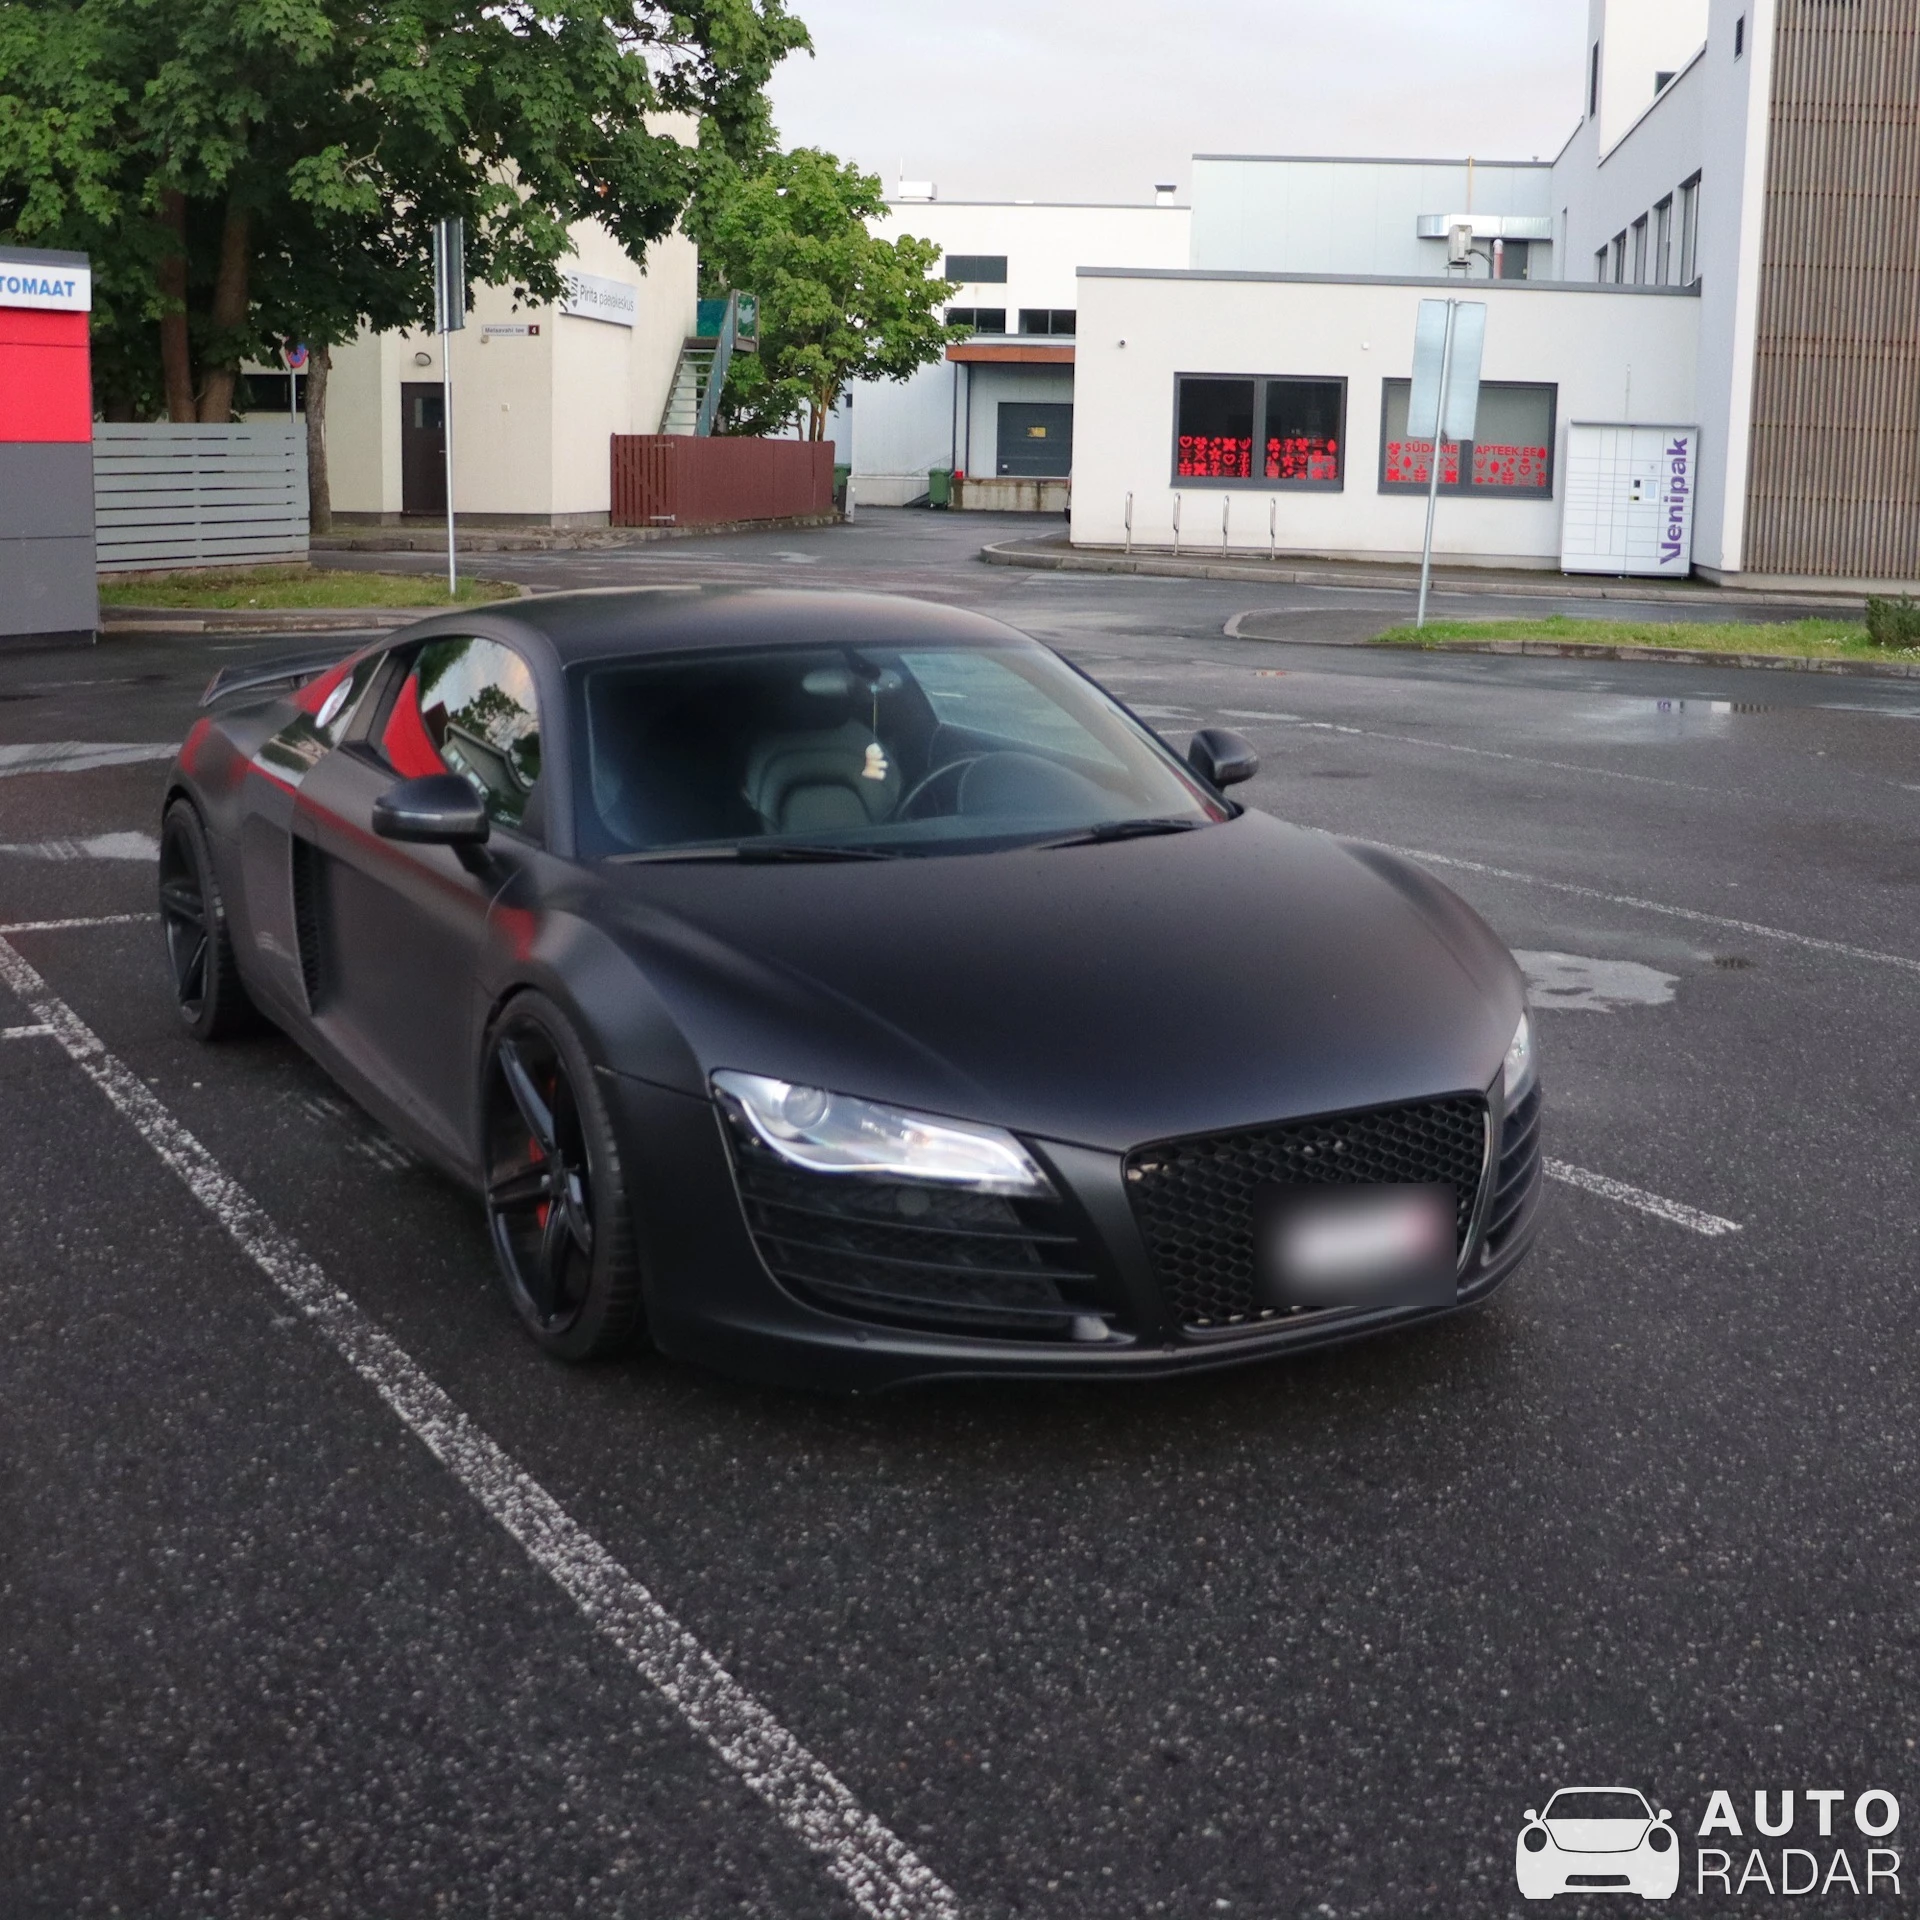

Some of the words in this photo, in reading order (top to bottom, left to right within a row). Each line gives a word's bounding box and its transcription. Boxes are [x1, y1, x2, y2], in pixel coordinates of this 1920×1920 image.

[580, 284, 598, 304] Pirita
[1474, 445, 1537, 457] APTEEK.EE
[1660, 438, 1689, 565] Venipak
